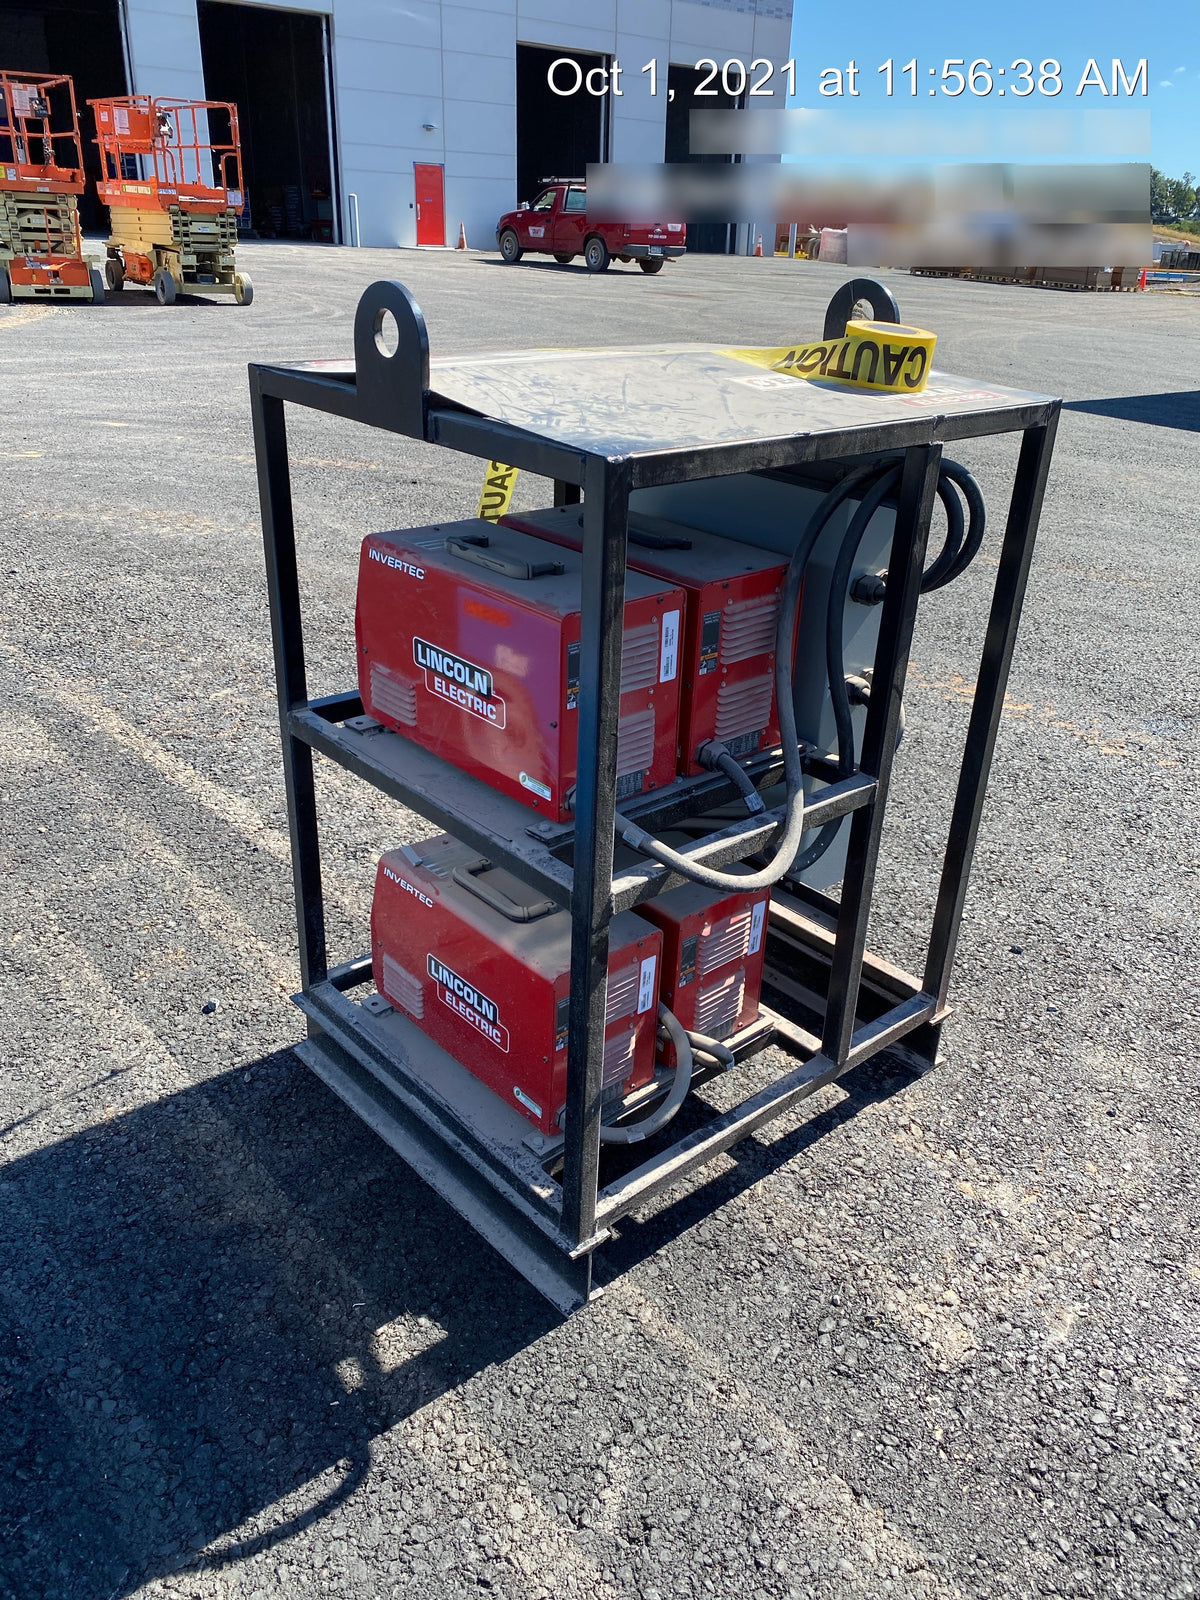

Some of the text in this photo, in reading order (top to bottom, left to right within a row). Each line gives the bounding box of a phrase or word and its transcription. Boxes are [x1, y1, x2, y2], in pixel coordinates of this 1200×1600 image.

[772, 335, 928, 388] CAUTION
[368, 548, 425, 580] INVERTEC
[417, 643, 487, 695] LINCOLN
[434, 676, 497, 720] ELECTRIC
[383, 867, 434, 908] INVERTEC
[431, 959, 494, 1022] LINCOLN
[445, 990, 502, 1043] ELECTRIC
